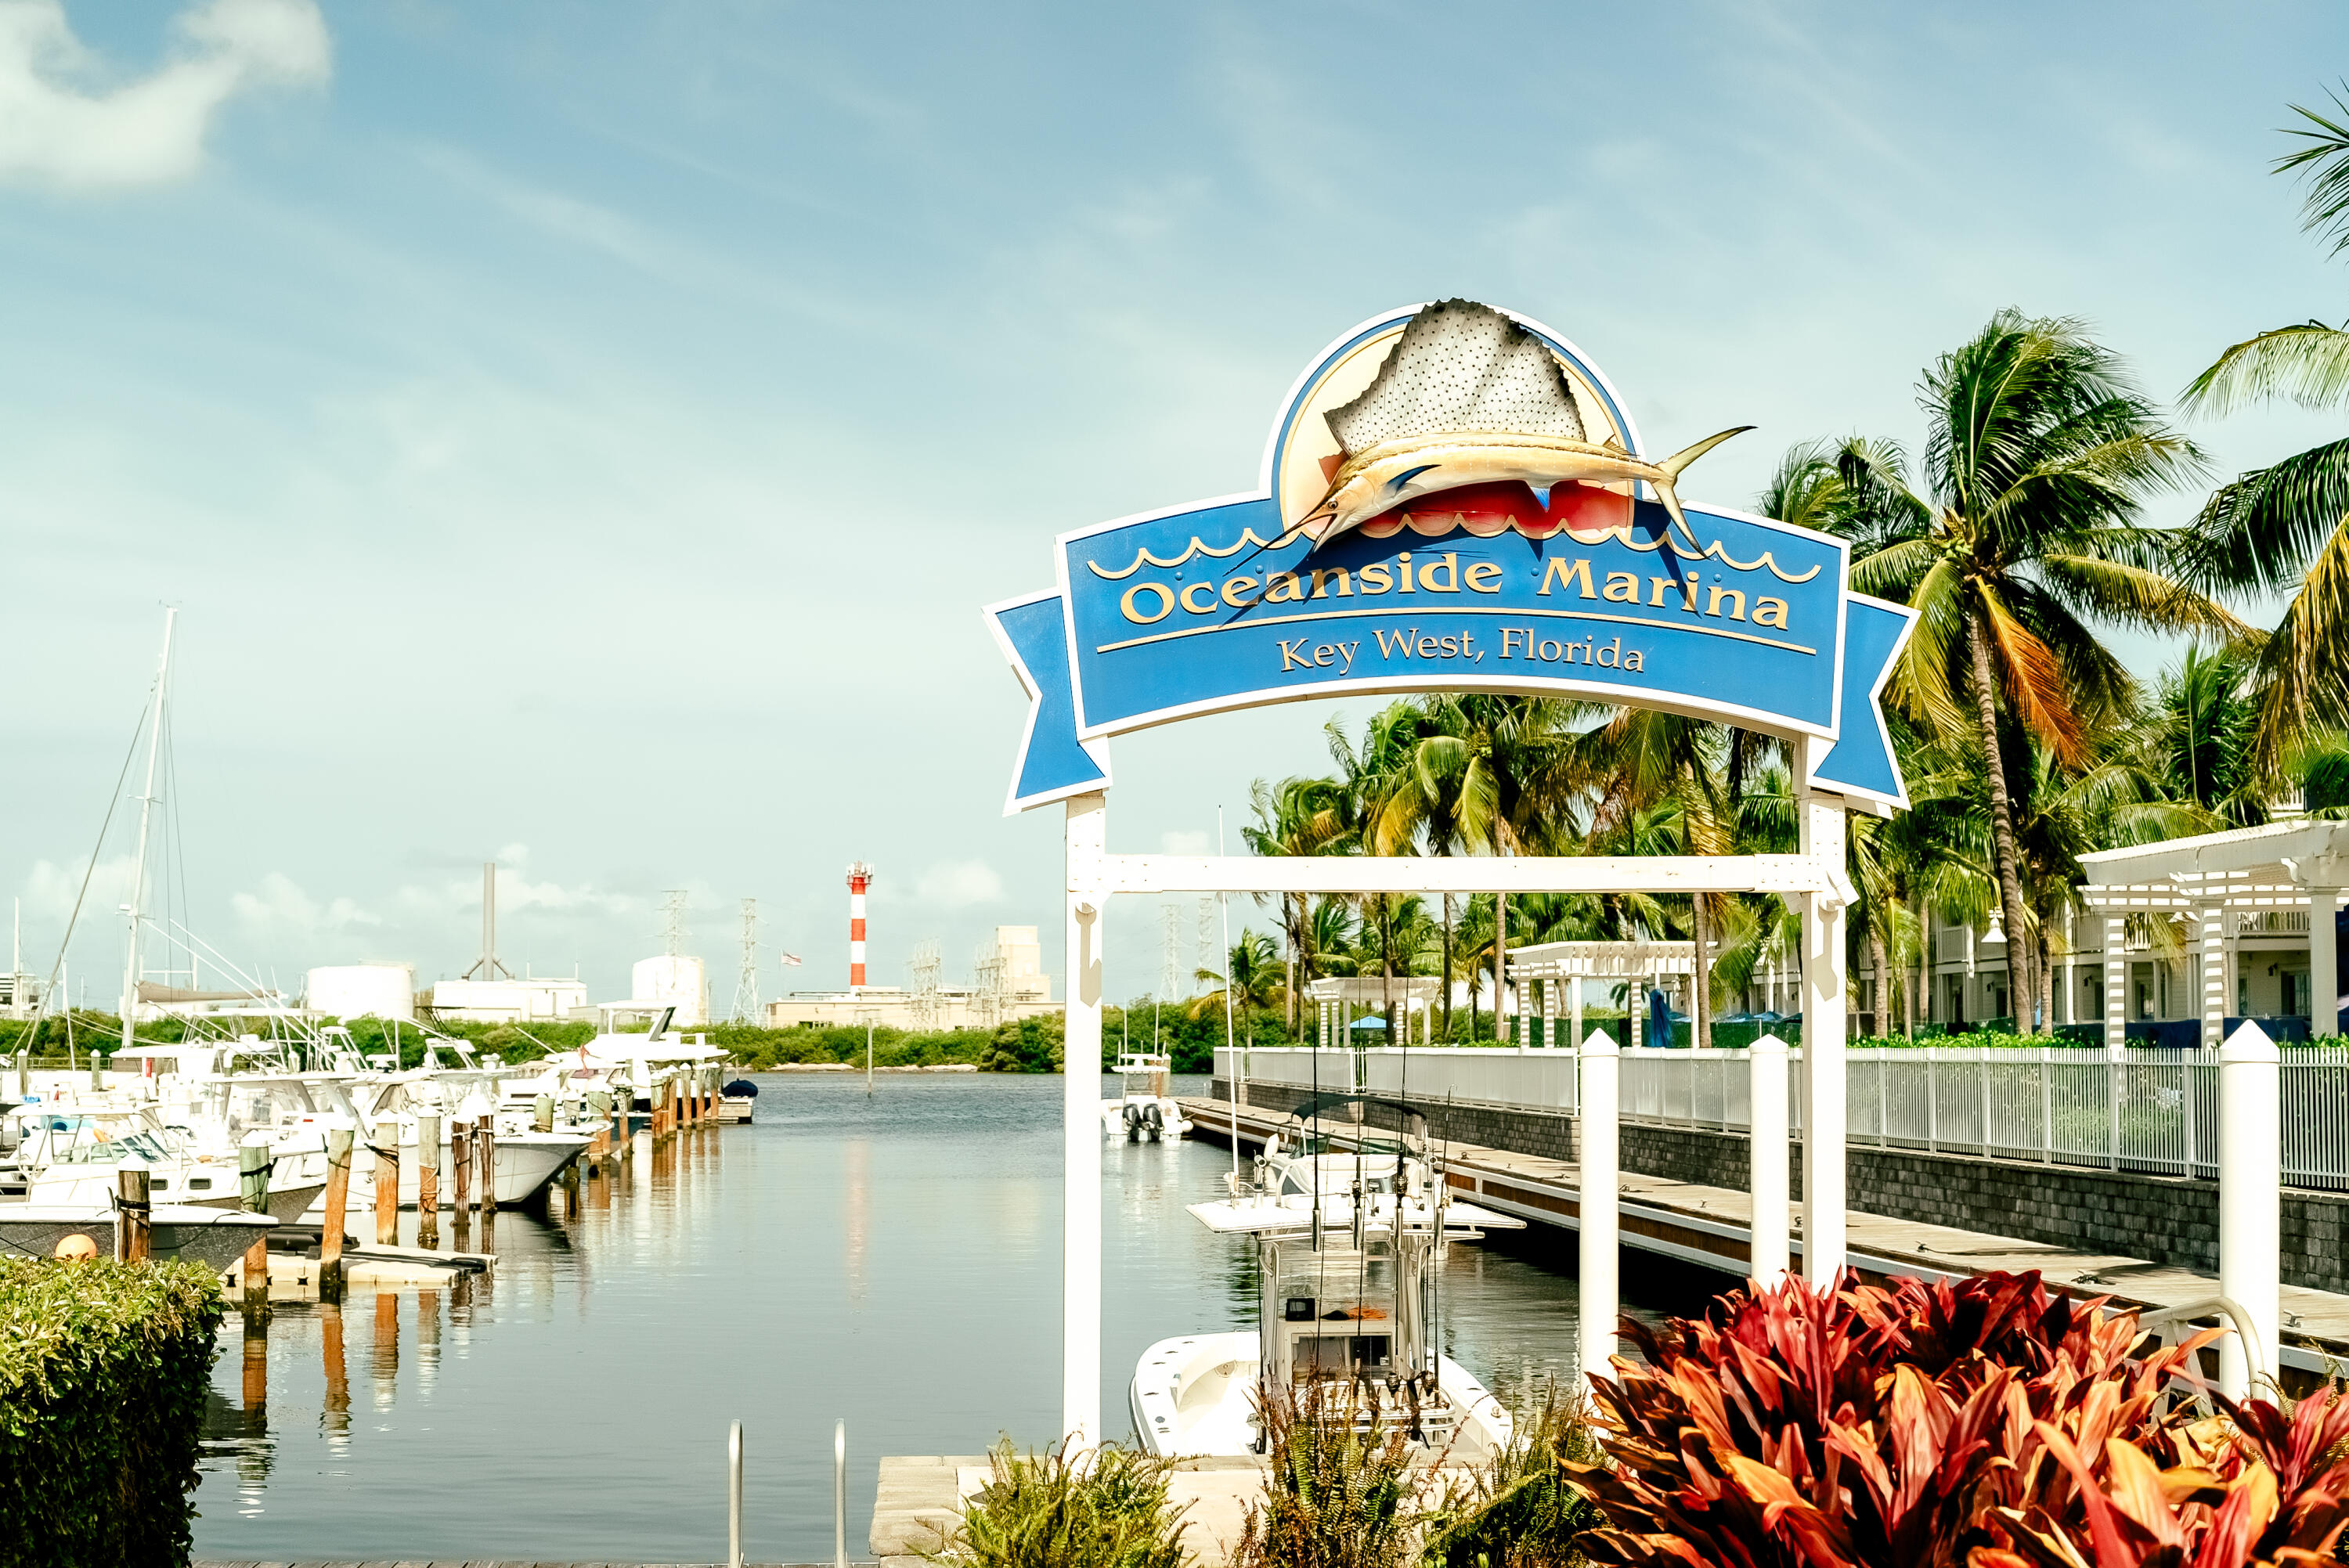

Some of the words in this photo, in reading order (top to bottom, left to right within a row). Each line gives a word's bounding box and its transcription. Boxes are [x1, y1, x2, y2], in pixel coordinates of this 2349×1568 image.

[1120, 551, 1503, 625] Oceanside
[1536, 557, 1789, 631] Marina
[1276, 638, 1360, 676] Key
[1372, 628, 1485, 665] West,
[1498, 627, 1644, 673] Florida
